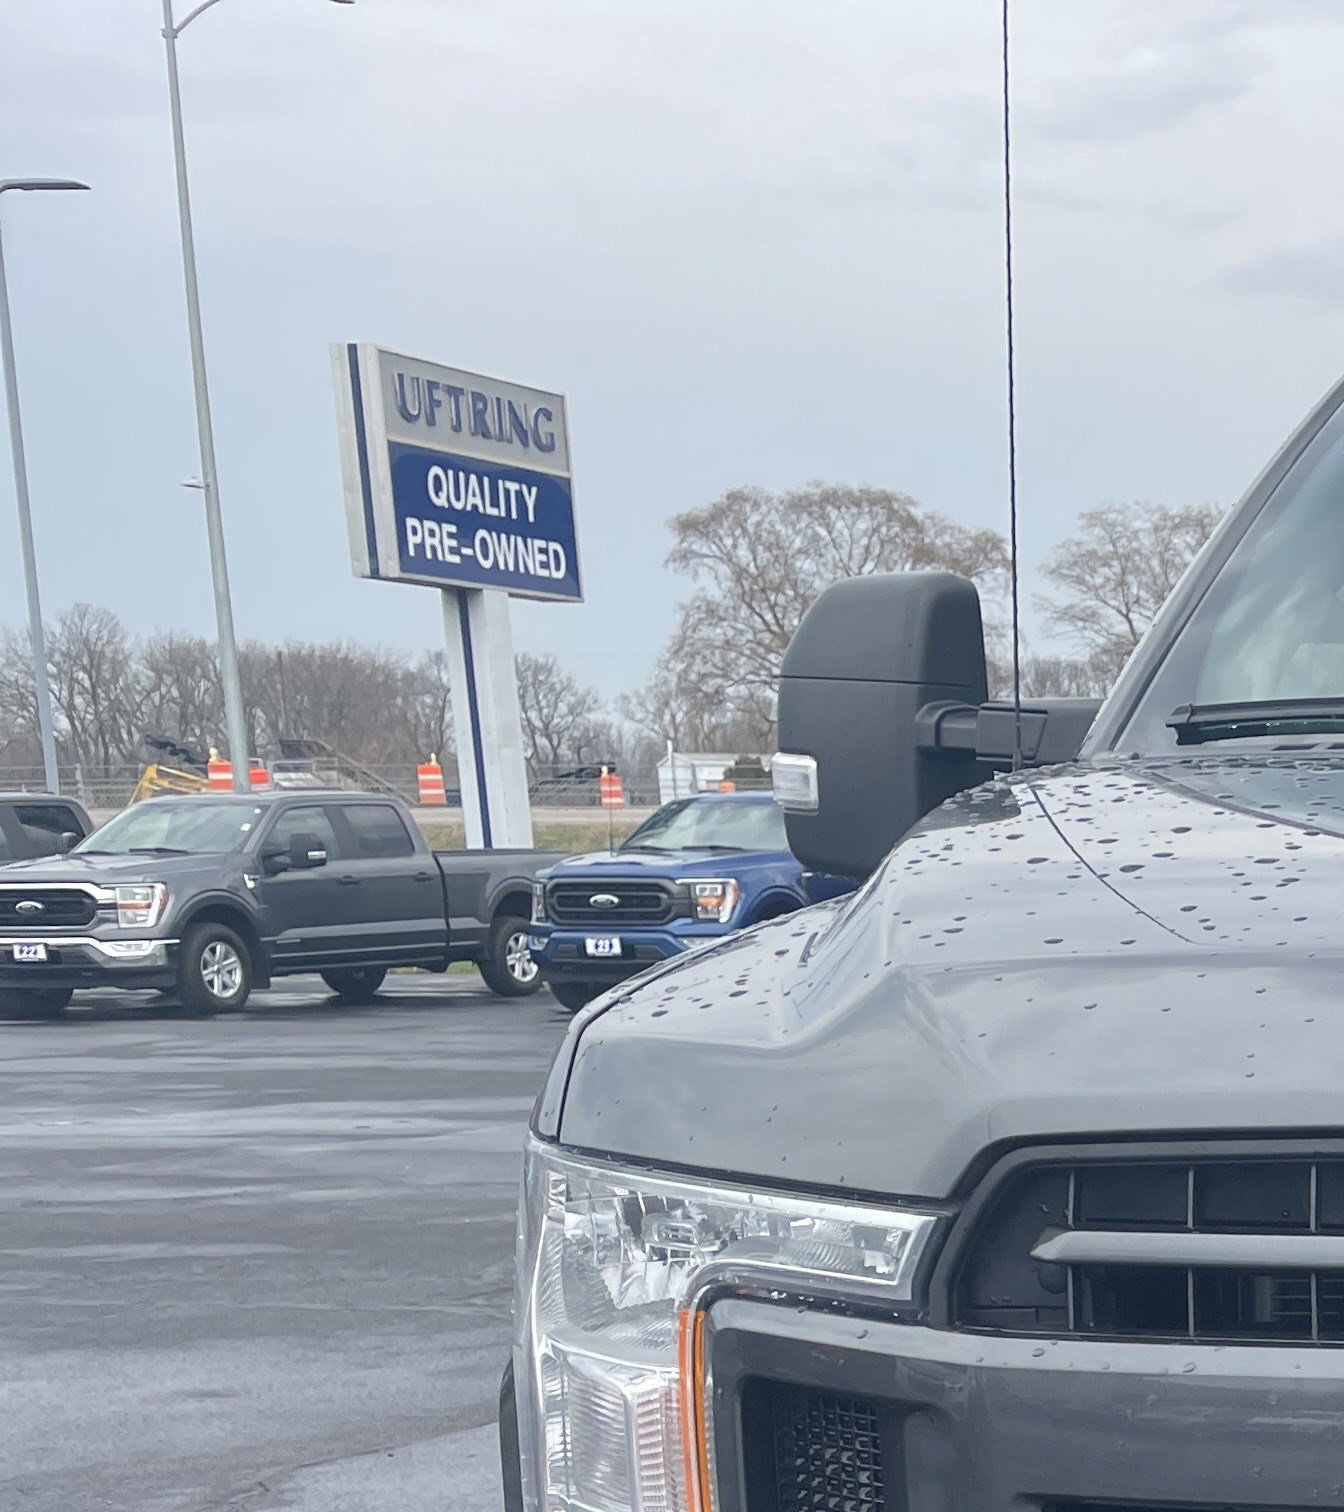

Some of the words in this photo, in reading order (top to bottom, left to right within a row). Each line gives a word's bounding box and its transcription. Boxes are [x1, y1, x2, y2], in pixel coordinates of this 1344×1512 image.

[395, 372, 556, 453] UFTRING
[427, 465, 538, 523] QUALITY
[405, 516, 567, 580] PRE-OWNED
